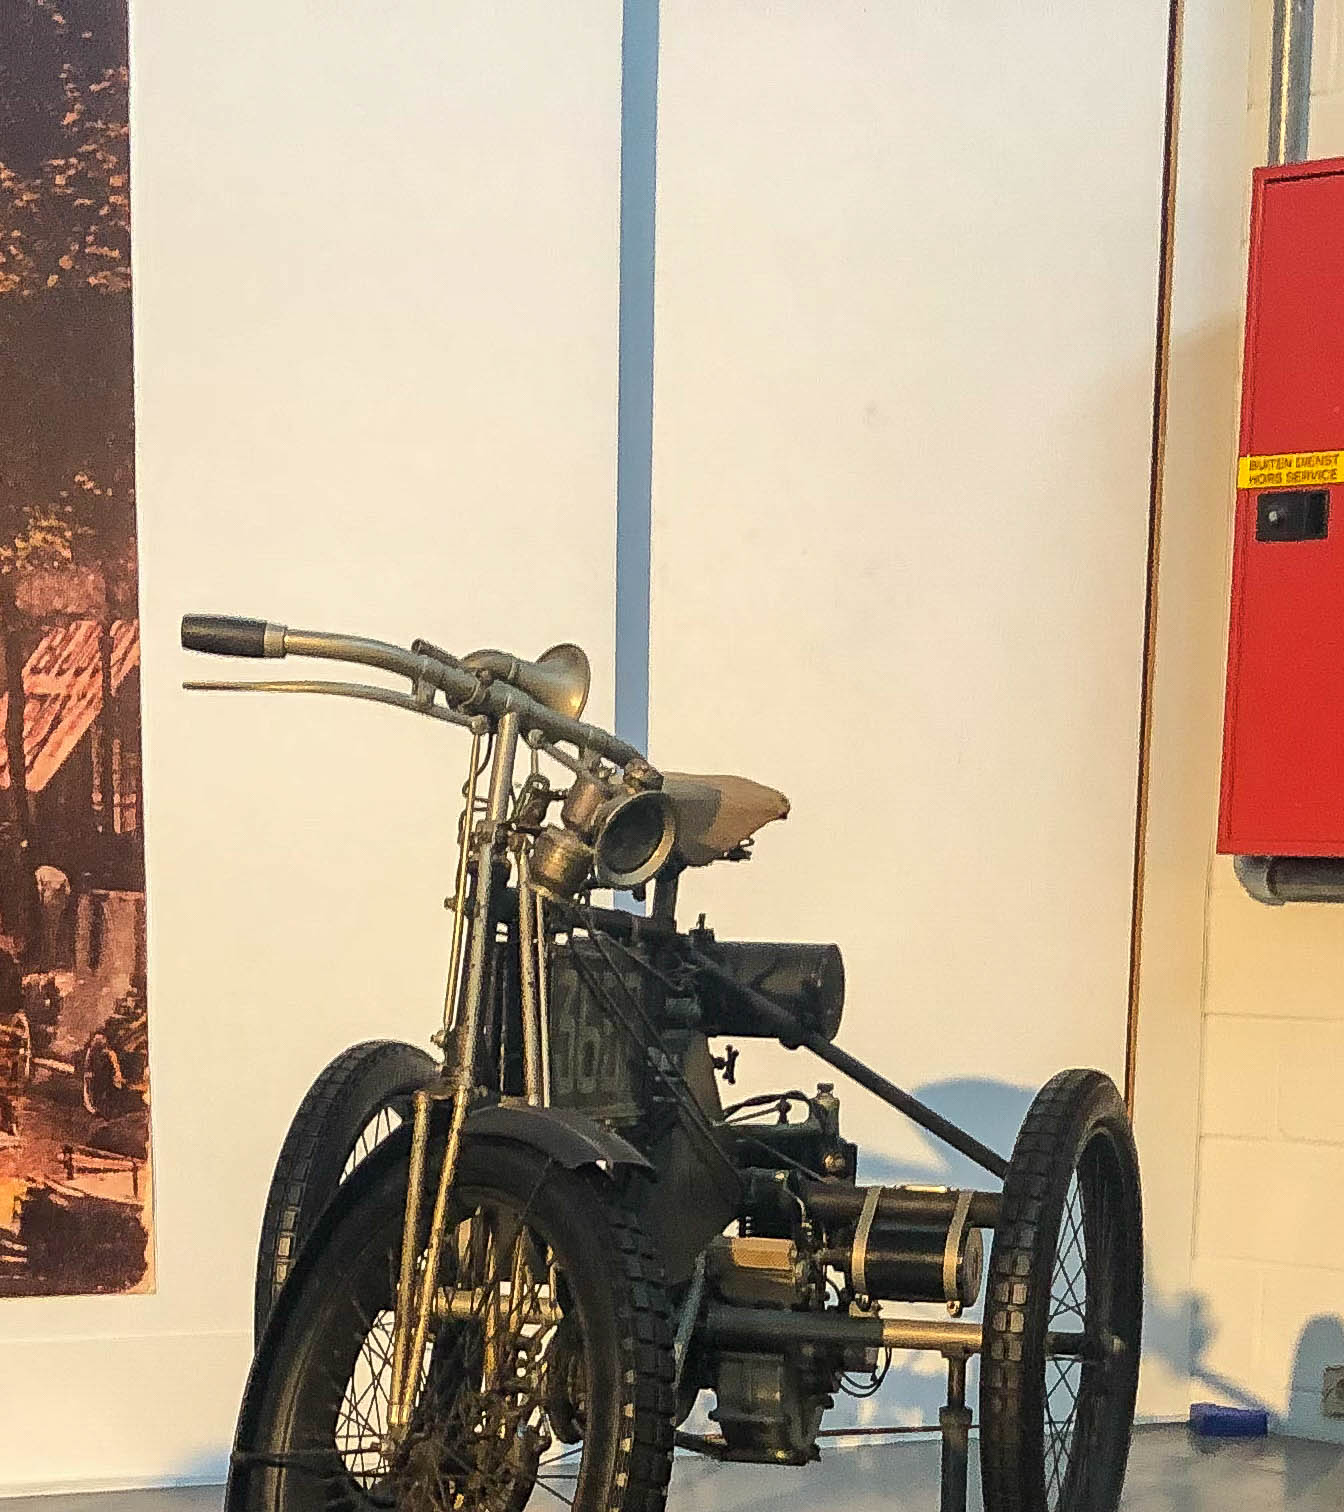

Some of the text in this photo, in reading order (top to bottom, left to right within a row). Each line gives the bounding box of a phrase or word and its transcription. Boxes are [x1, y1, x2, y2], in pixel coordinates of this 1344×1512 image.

[1249, 453, 1340, 471] BUITEN DIENST
[1249, 468, 1338, 485] HORS SERVICE
